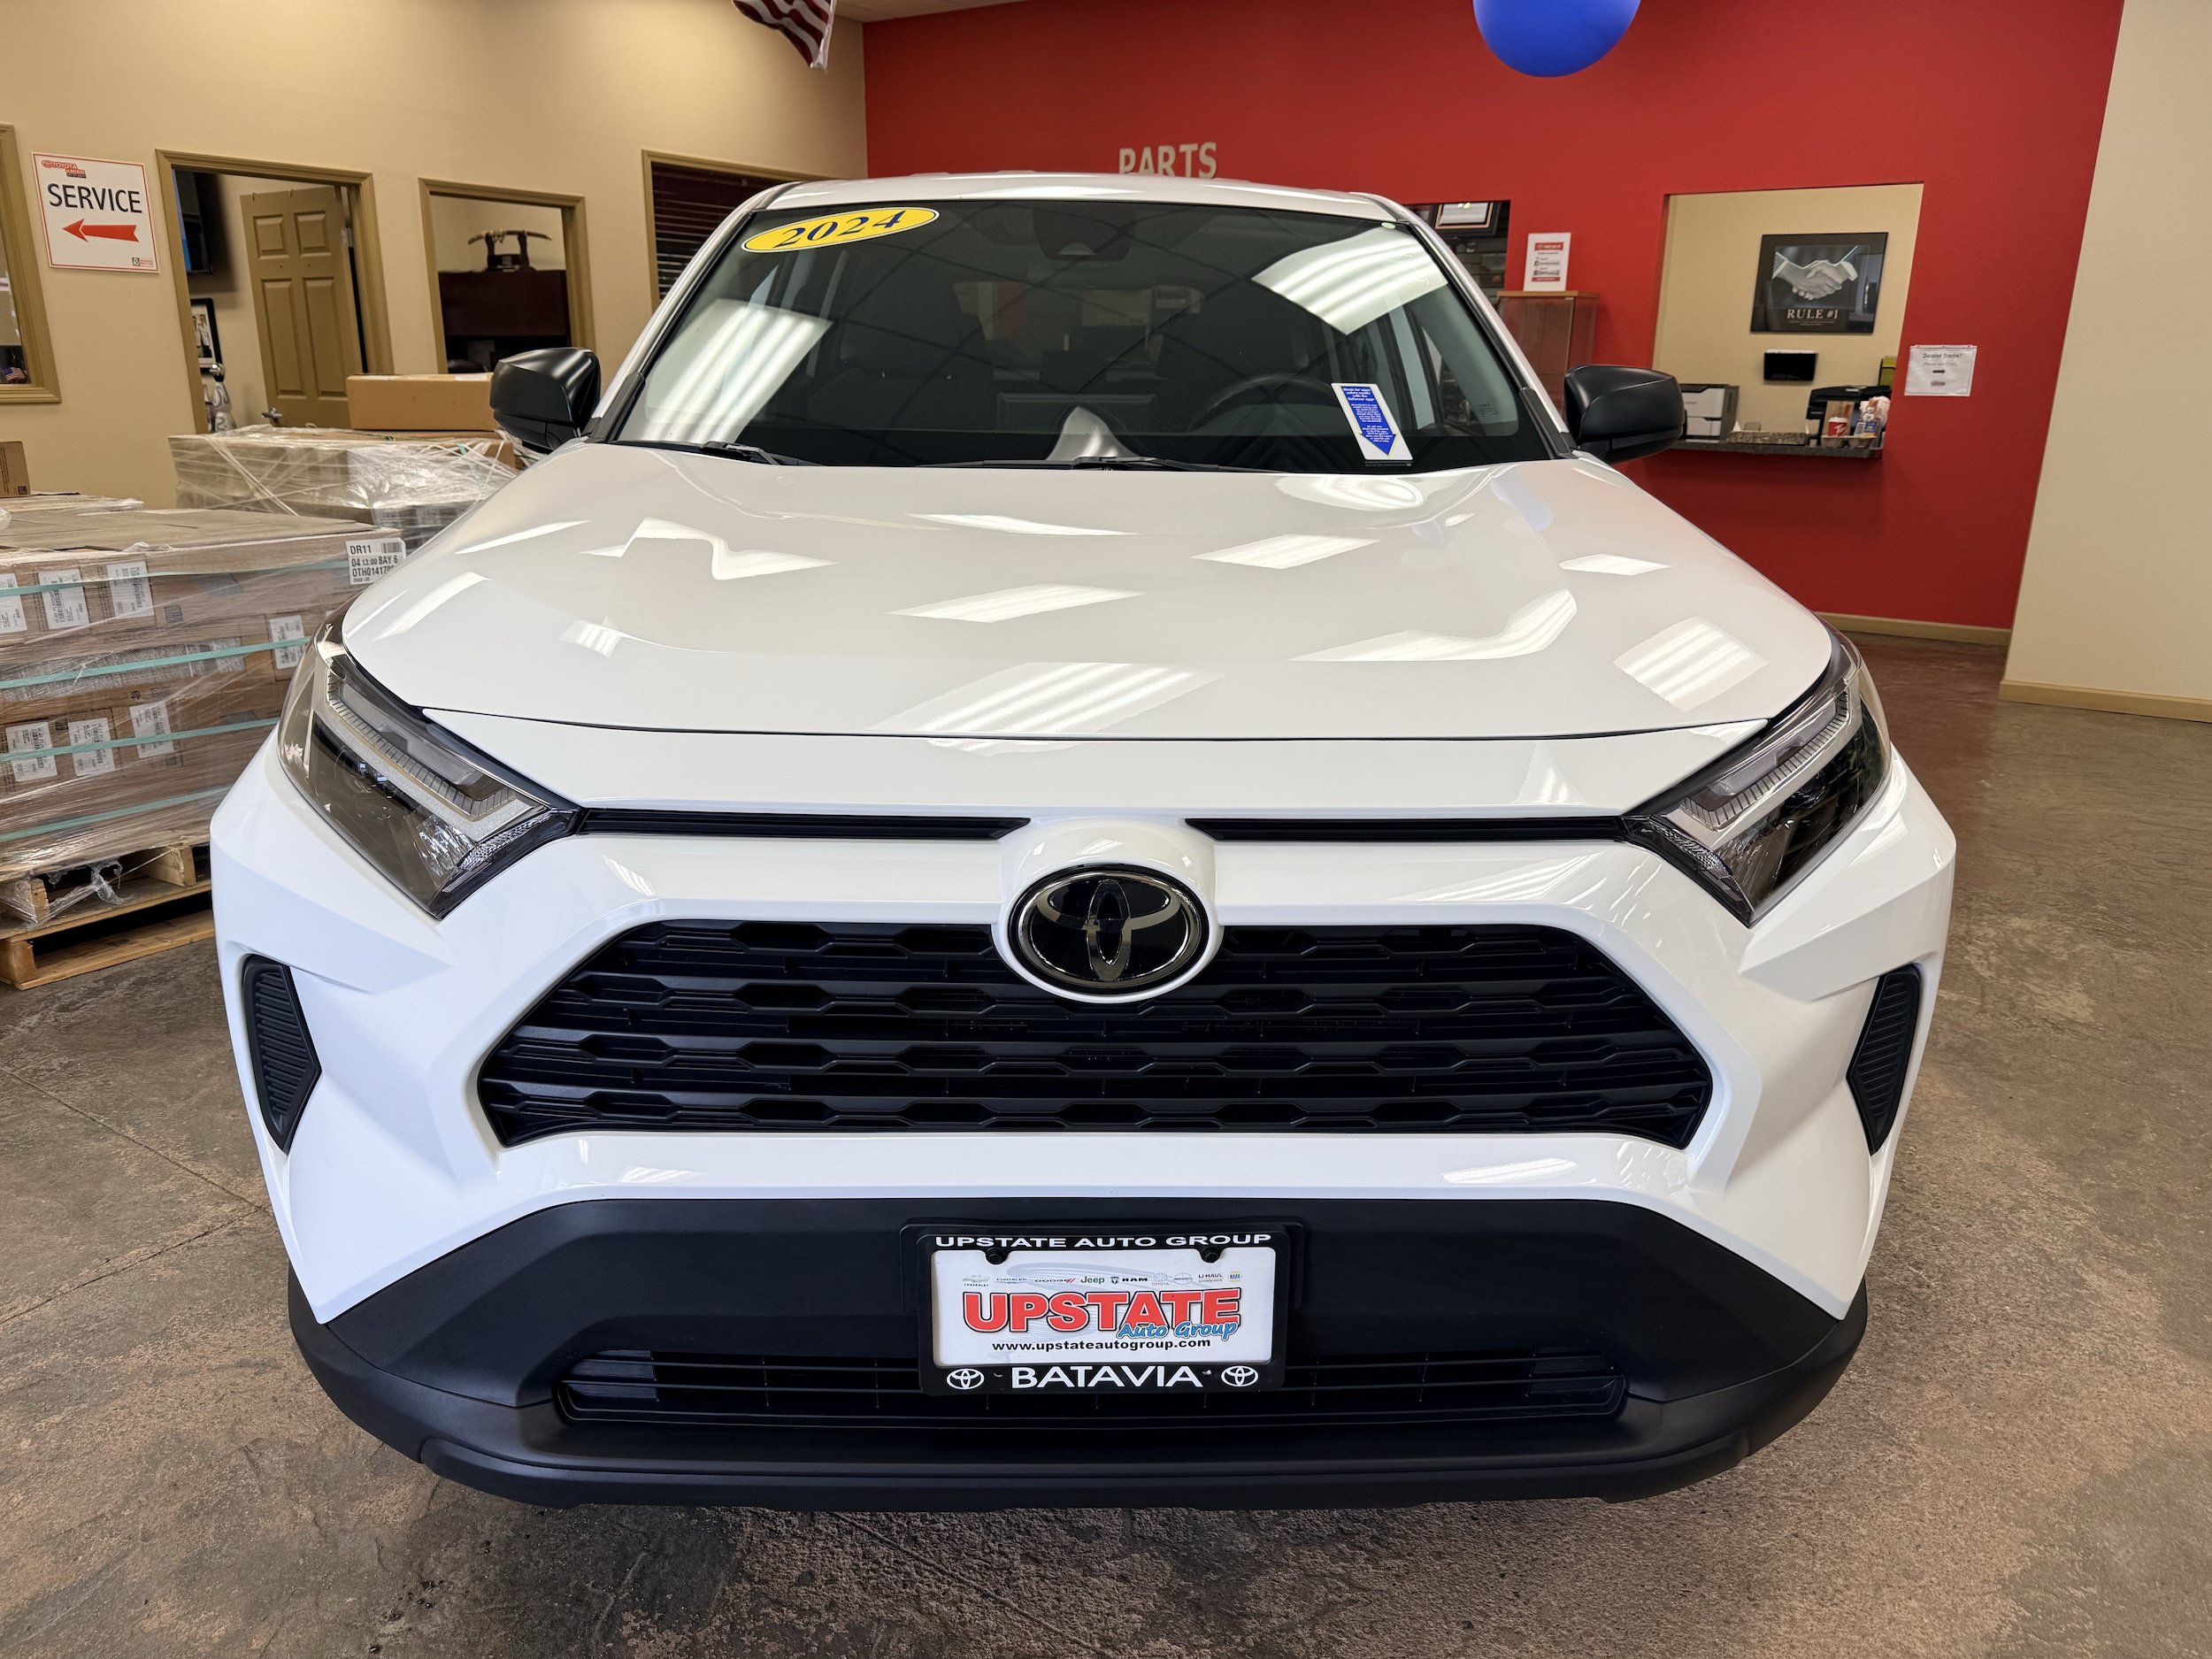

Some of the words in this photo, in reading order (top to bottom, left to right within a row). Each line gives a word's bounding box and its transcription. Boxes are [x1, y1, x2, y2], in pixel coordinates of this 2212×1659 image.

[1118, 141, 1217, 180] PARTS
[47, 183, 142, 213] SERVICE
[771, 210, 908, 249] 2024
[1786, 308, 1824, 319] RULE
[1826, 309, 1839, 319] #1
[349, 545, 372, 555] DR11
[351, 558, 361, 567] 04
[378, 555, 392, 565] BAY
[393, 555, 398, 564] 6
[935, 1236, 1066, 1248] UPSTATE
[1074, 1236, 1156, 1248] AUTO
[1165, 1233, 1271, 1246] GROUP
[1080, 1276, 1105, 1285] Jeep
[963, 1287, 1241, 1333] UPSTATE
[1118, 1322, 1167, 1338] Auto
[1172, 1321, 1240, 1339] Group
[992, 1339, 1212, 1351] www.upstateautogroup.com
[1011, 1366, 1203, 1389] BATAVIA
